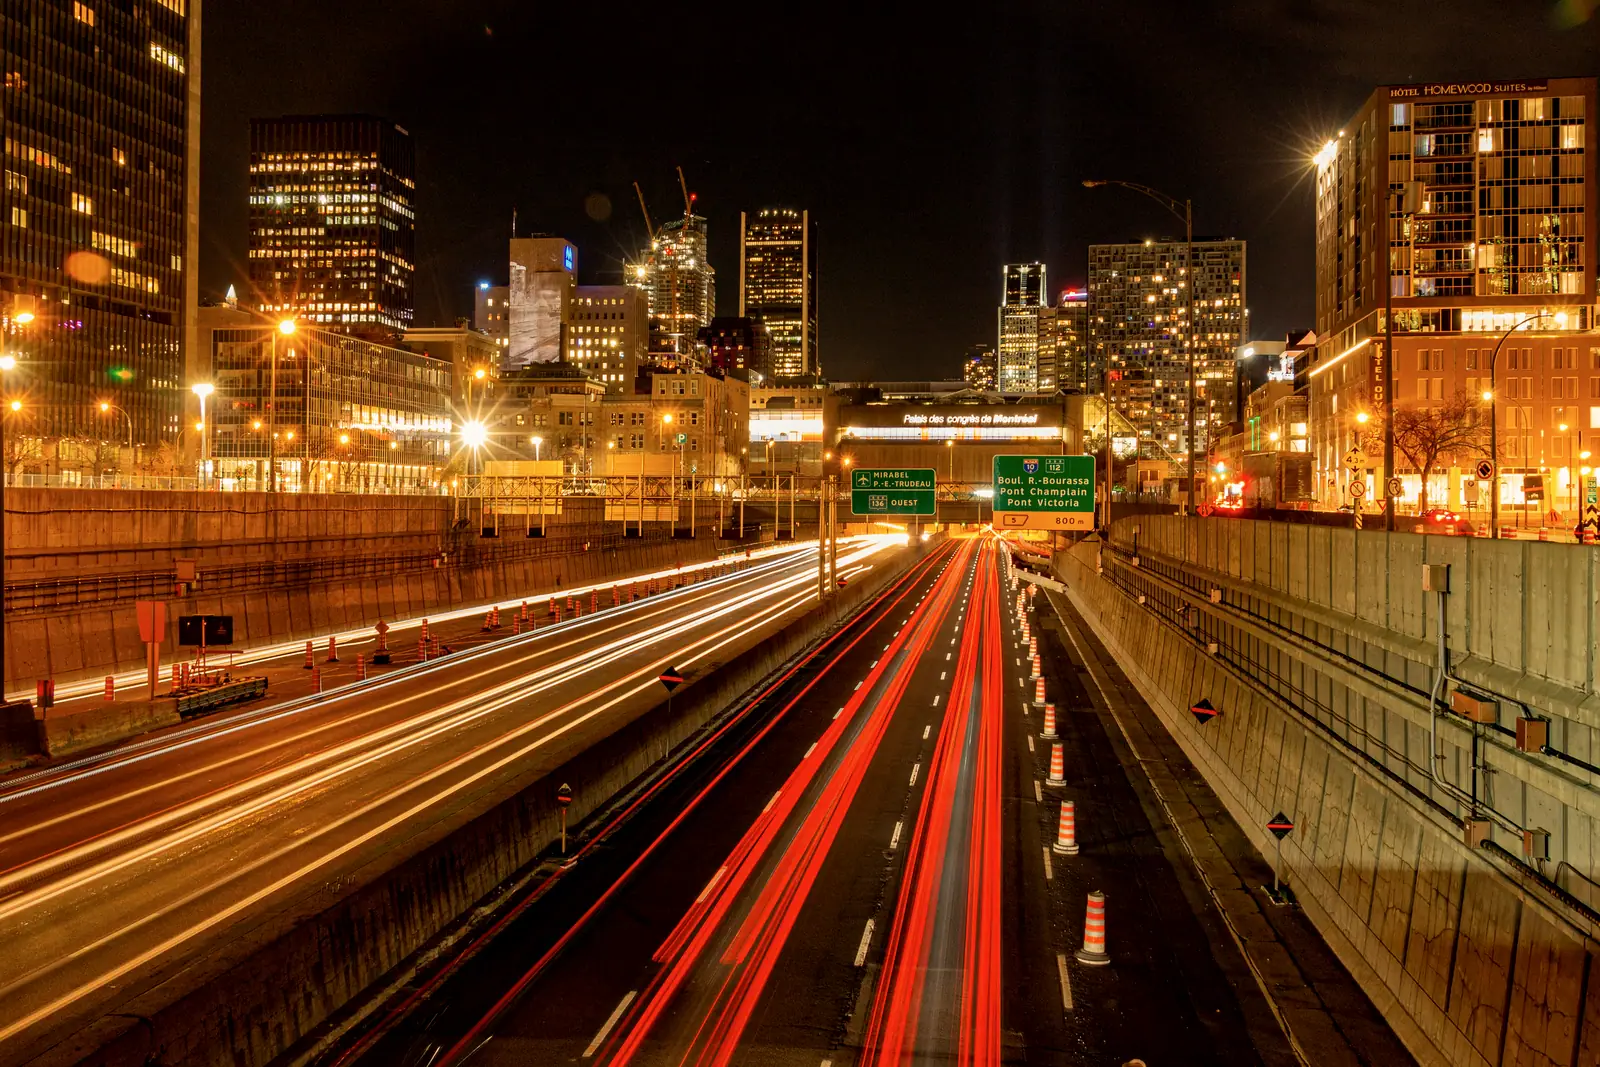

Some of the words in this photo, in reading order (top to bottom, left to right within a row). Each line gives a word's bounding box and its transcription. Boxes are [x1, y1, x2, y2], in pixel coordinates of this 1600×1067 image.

[1390, 88, 1419, 97] HÔTEL
[1424, 83, 1492, 95] HOMEWOOD
[1494, 84, 1526, 92] SUITES
[904, 414, 927, 424] Palais
[929, 415, 944, 423] des
[947, 414, 980, 425] congrès
[981, 414, 992, 423] de
[993, 413, 1038, 424] Montréal
[678, 433, 686, 443] P
[873, 471, 910, 479] MIRABEL
[873, 480, 931, 488] P.-E.-TRUDEAU
[998, 476, 1024, 485] Boul.
[1028, 476, 1090, 485] R.-Bourassa
[1000, 487, 1025, 496] Pont
[1029, 487, 1088, 498] Champlain
[891, 499, 918, 507] OUEST
[1007, 498, 1032, 507] Pont
[1037, 498, 1080, 508] Victoria
[1055, 517, 1076, 525] 800
